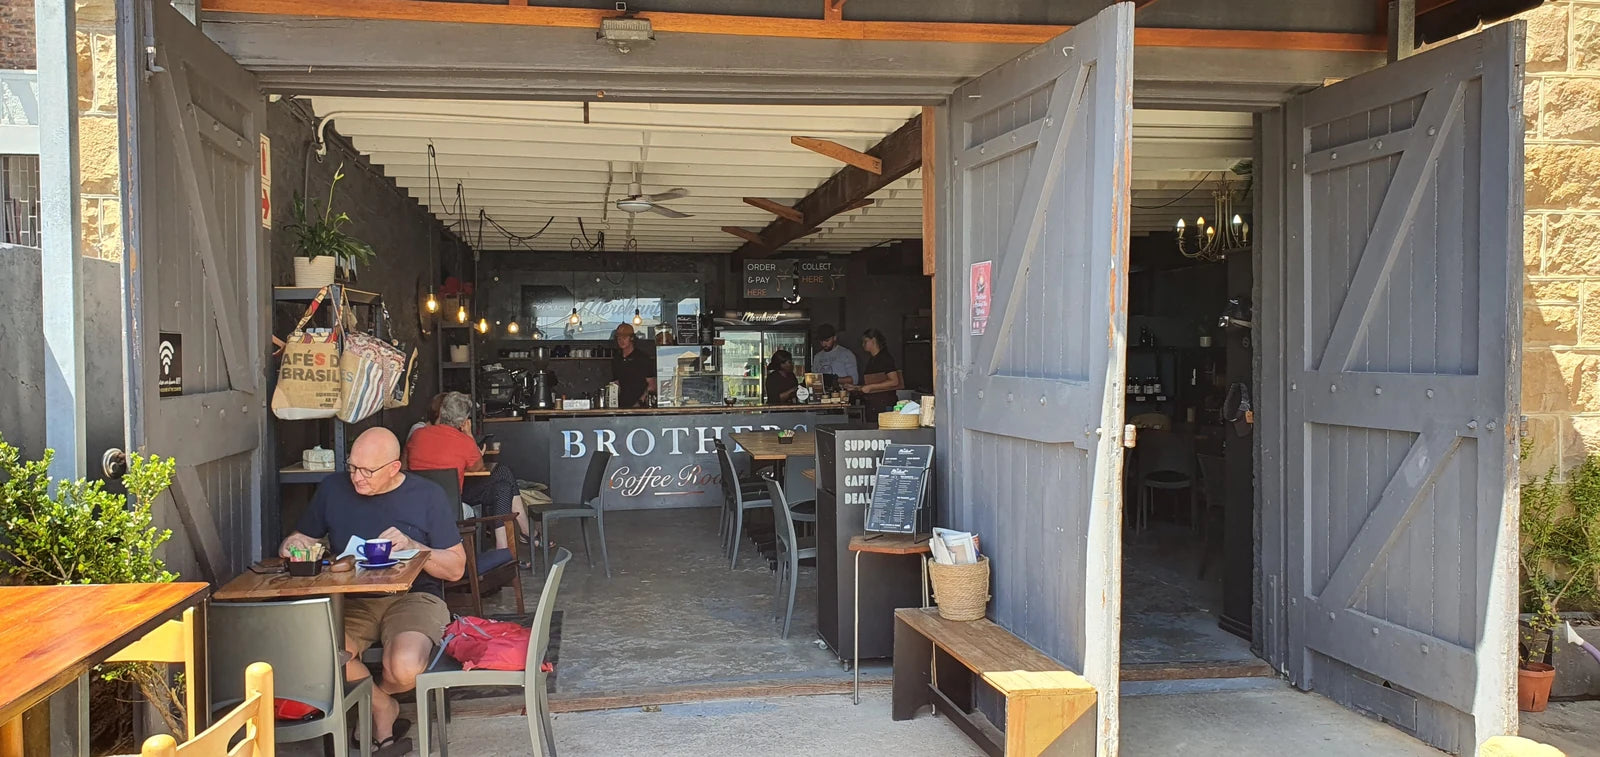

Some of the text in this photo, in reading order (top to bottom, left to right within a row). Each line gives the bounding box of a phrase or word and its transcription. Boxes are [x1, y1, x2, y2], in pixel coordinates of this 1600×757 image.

[747, 263, 776, 271] ORDER
[802, 262, 831, 271] COLLECT
[747, 276, 770, 284] & PAY
[802, 275, 824, 283] HERE
[281, 368, 340, 383] BRASIL
[561, 424, 808, 458] BROTH
[844, 439, 892, 452] SUPPORT
[844, 457, 873, 469] YOUR
[609, 465, 675, 497] Coffee
